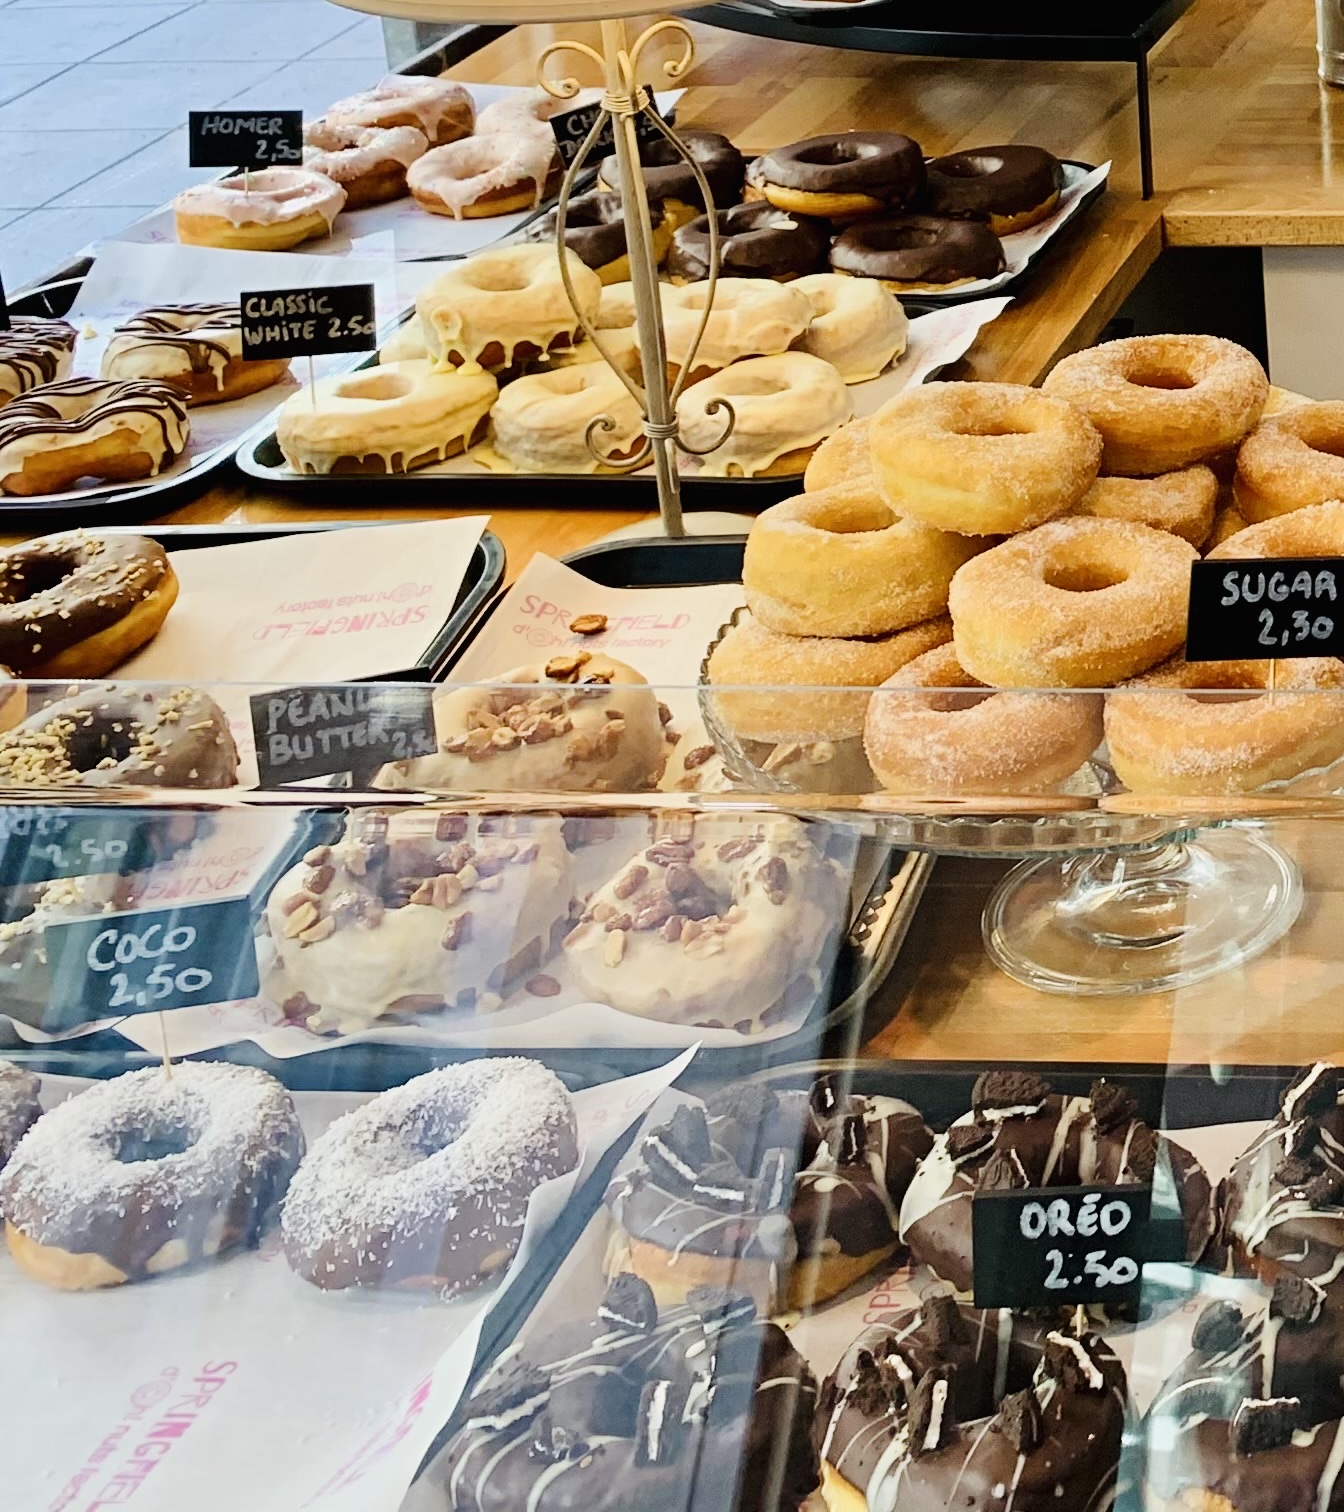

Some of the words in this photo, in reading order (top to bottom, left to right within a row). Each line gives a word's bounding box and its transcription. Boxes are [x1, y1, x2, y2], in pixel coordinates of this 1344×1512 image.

[201, 115, 283, 136] HOMER
[1220, 568, 1338, 607] SUGAR
[252, 604, 431, 641] SPRINGFIELD
[1256, 608, 1335, 648] 2,30
[87, 923, 197, 972] COCO
[108, 962, 213, 1008] 2,50
[1019, 1192, 1132, 1239] ORÉO
[1043, 1248, 1139, 1290] 2.50
